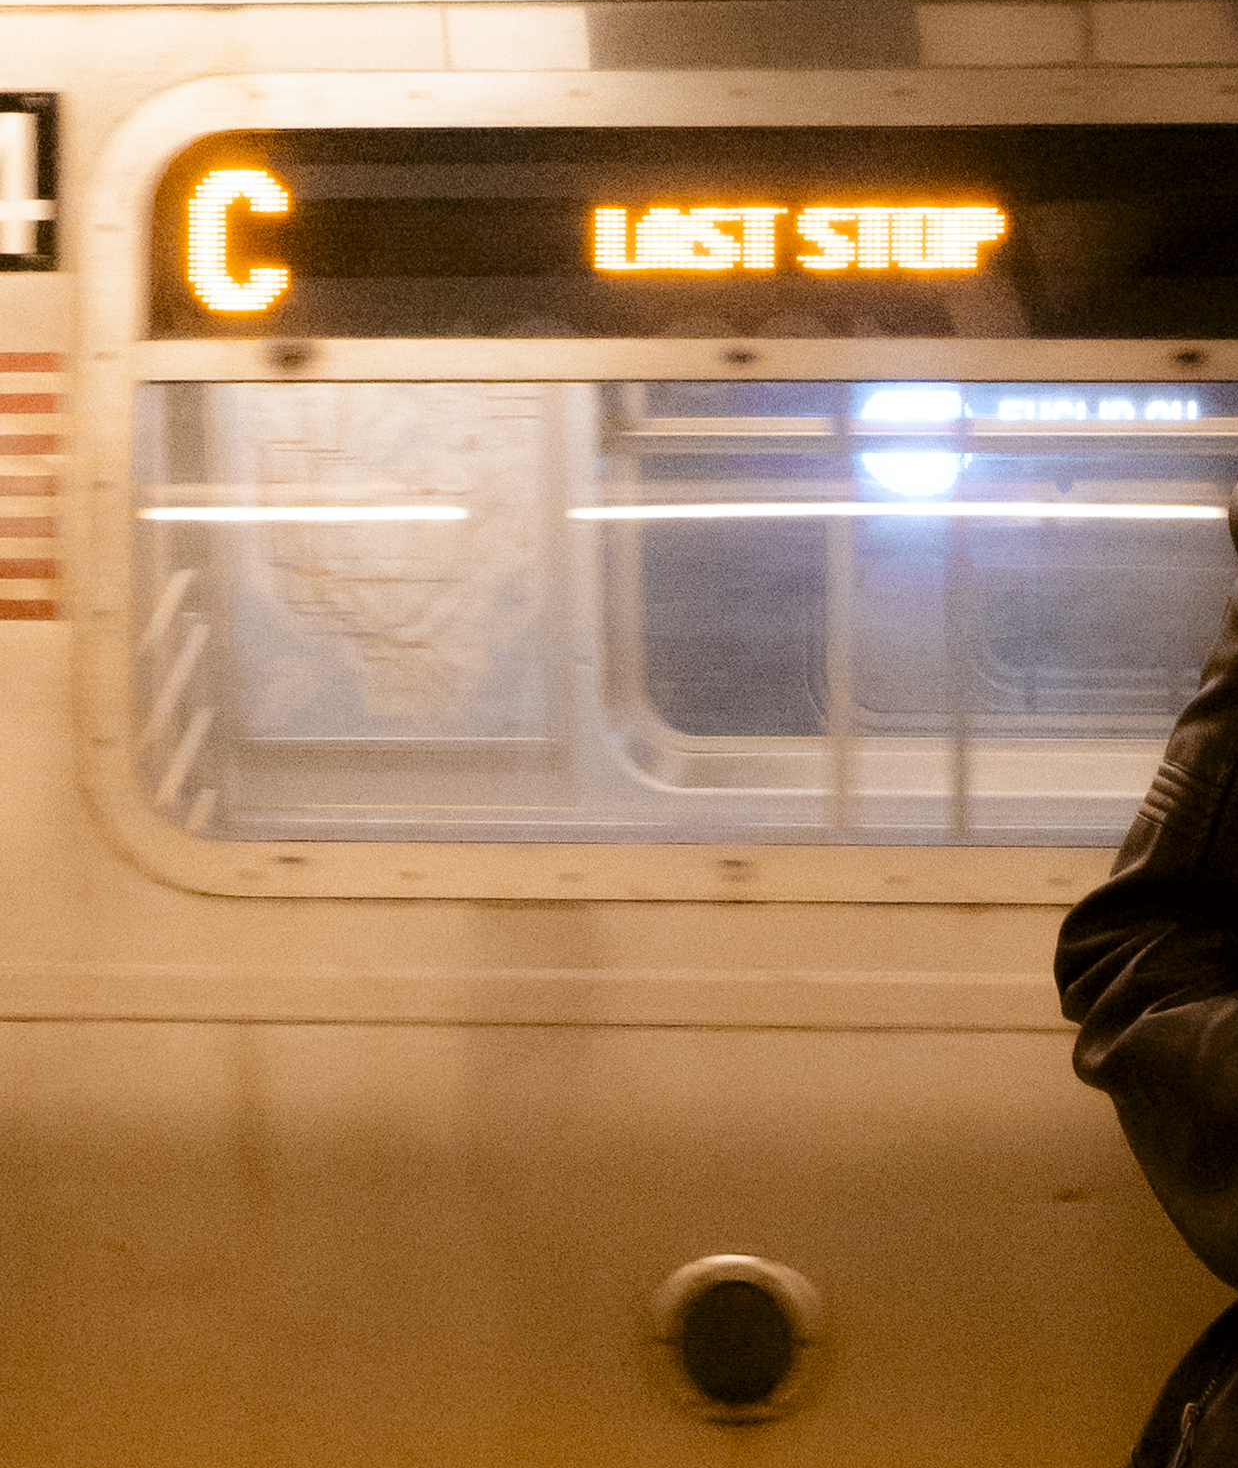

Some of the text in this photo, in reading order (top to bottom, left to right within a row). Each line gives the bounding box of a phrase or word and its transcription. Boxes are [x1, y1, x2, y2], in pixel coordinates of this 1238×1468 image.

[187, 169, 290, 311] C
[594, 206, 1006, 269] LAST STOP
